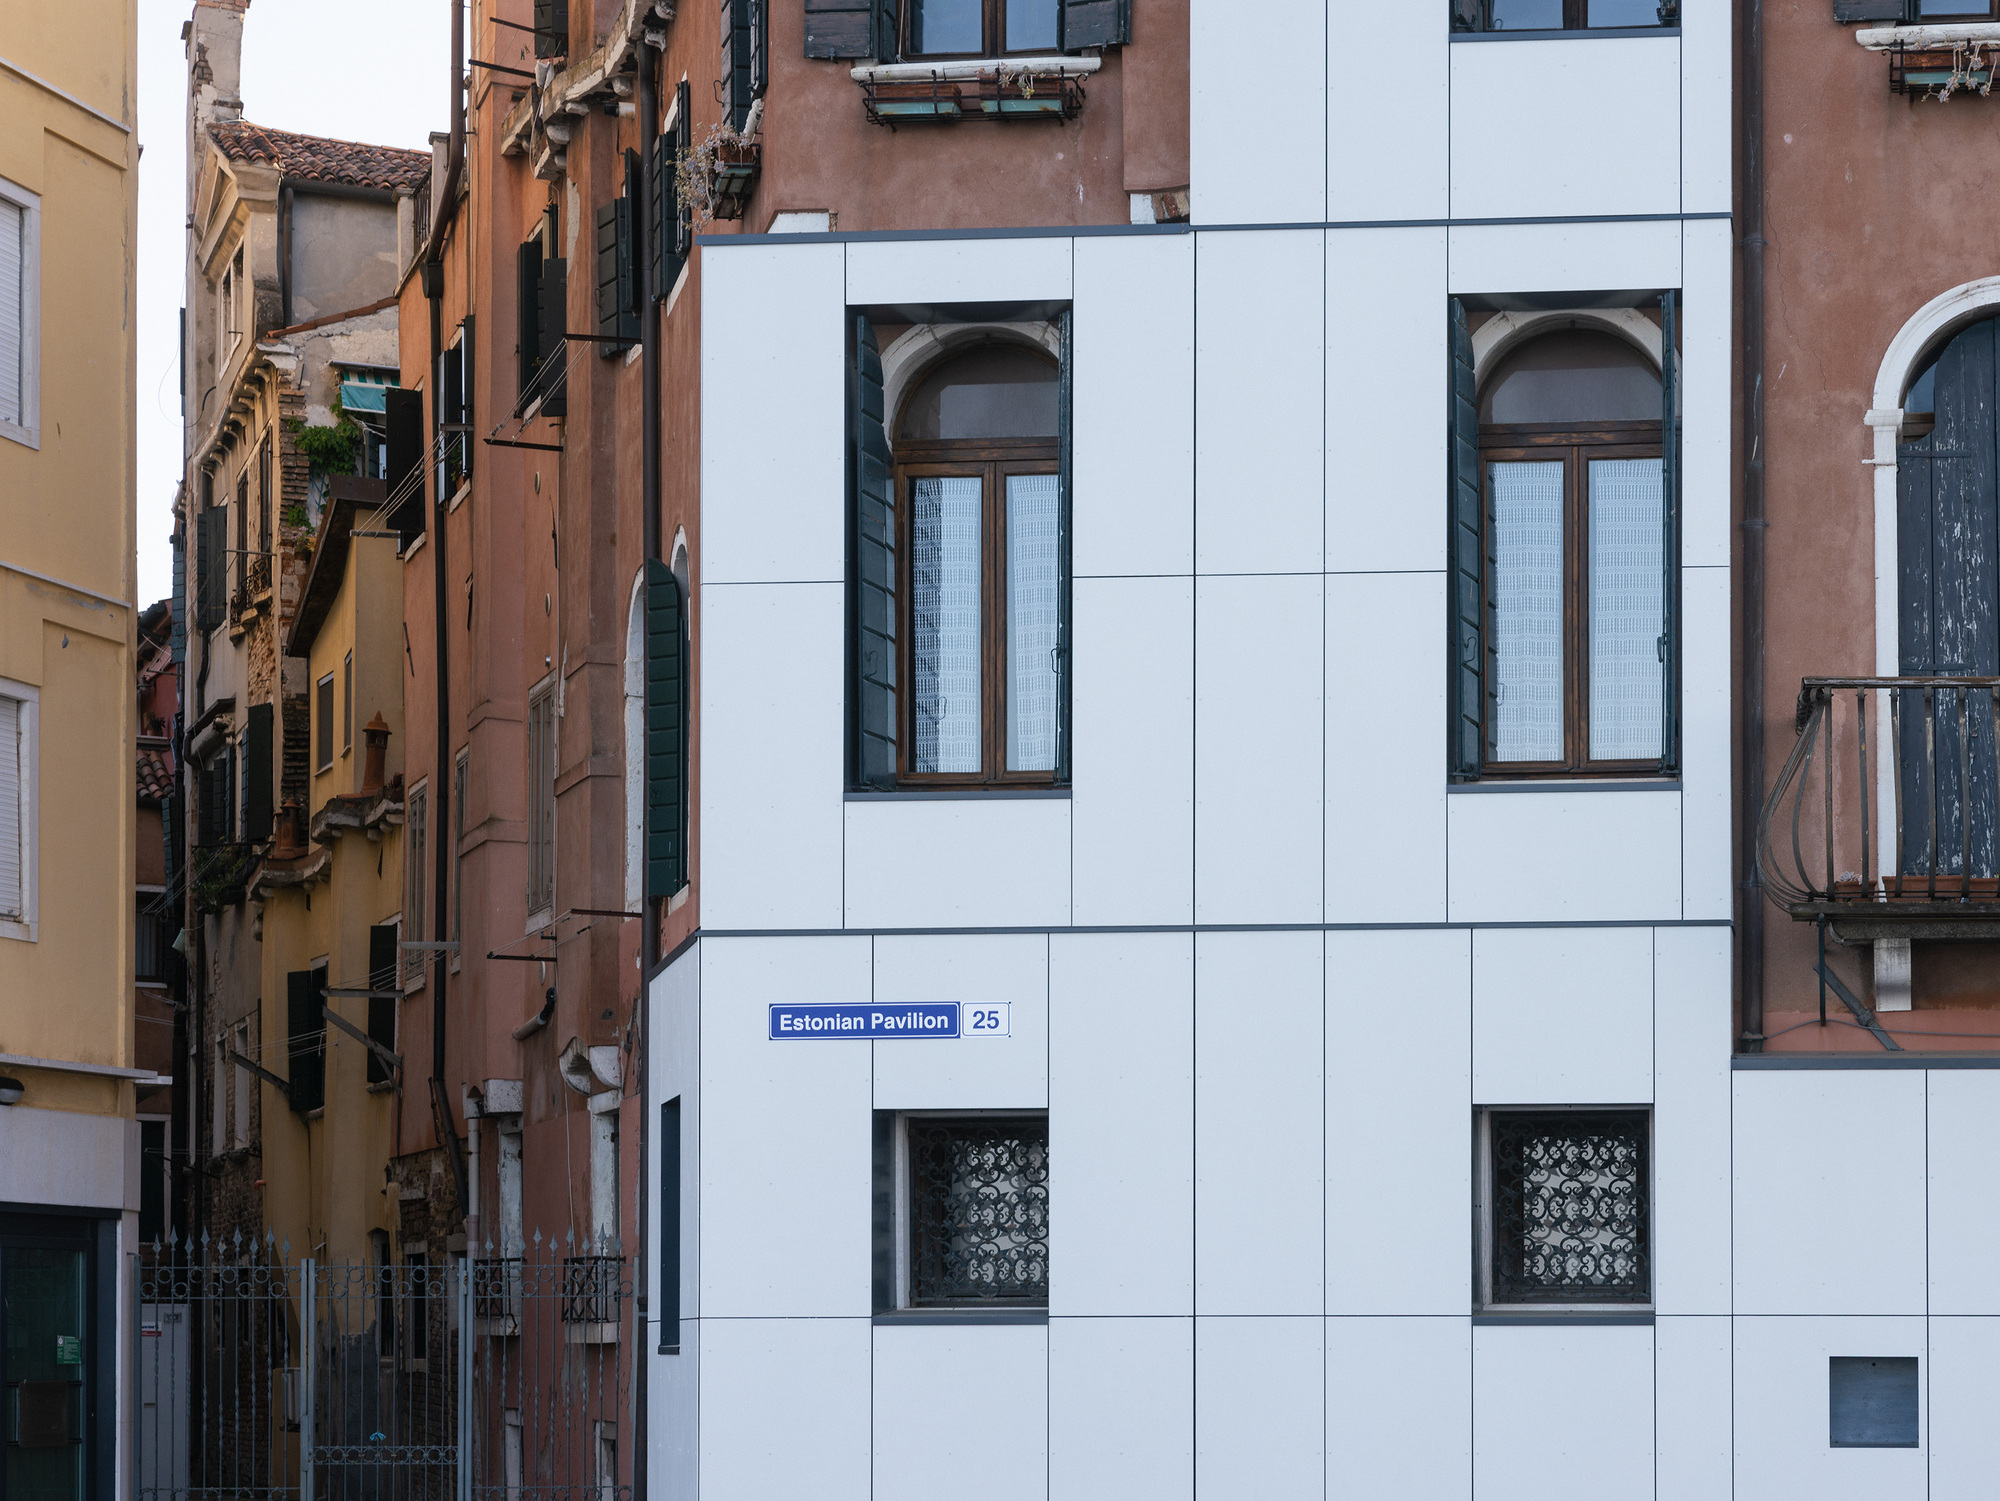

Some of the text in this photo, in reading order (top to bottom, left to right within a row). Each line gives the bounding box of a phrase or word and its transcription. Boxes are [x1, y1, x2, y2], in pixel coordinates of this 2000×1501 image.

[780, 1010, 1000, 1031] Estonian Pavilion 25
